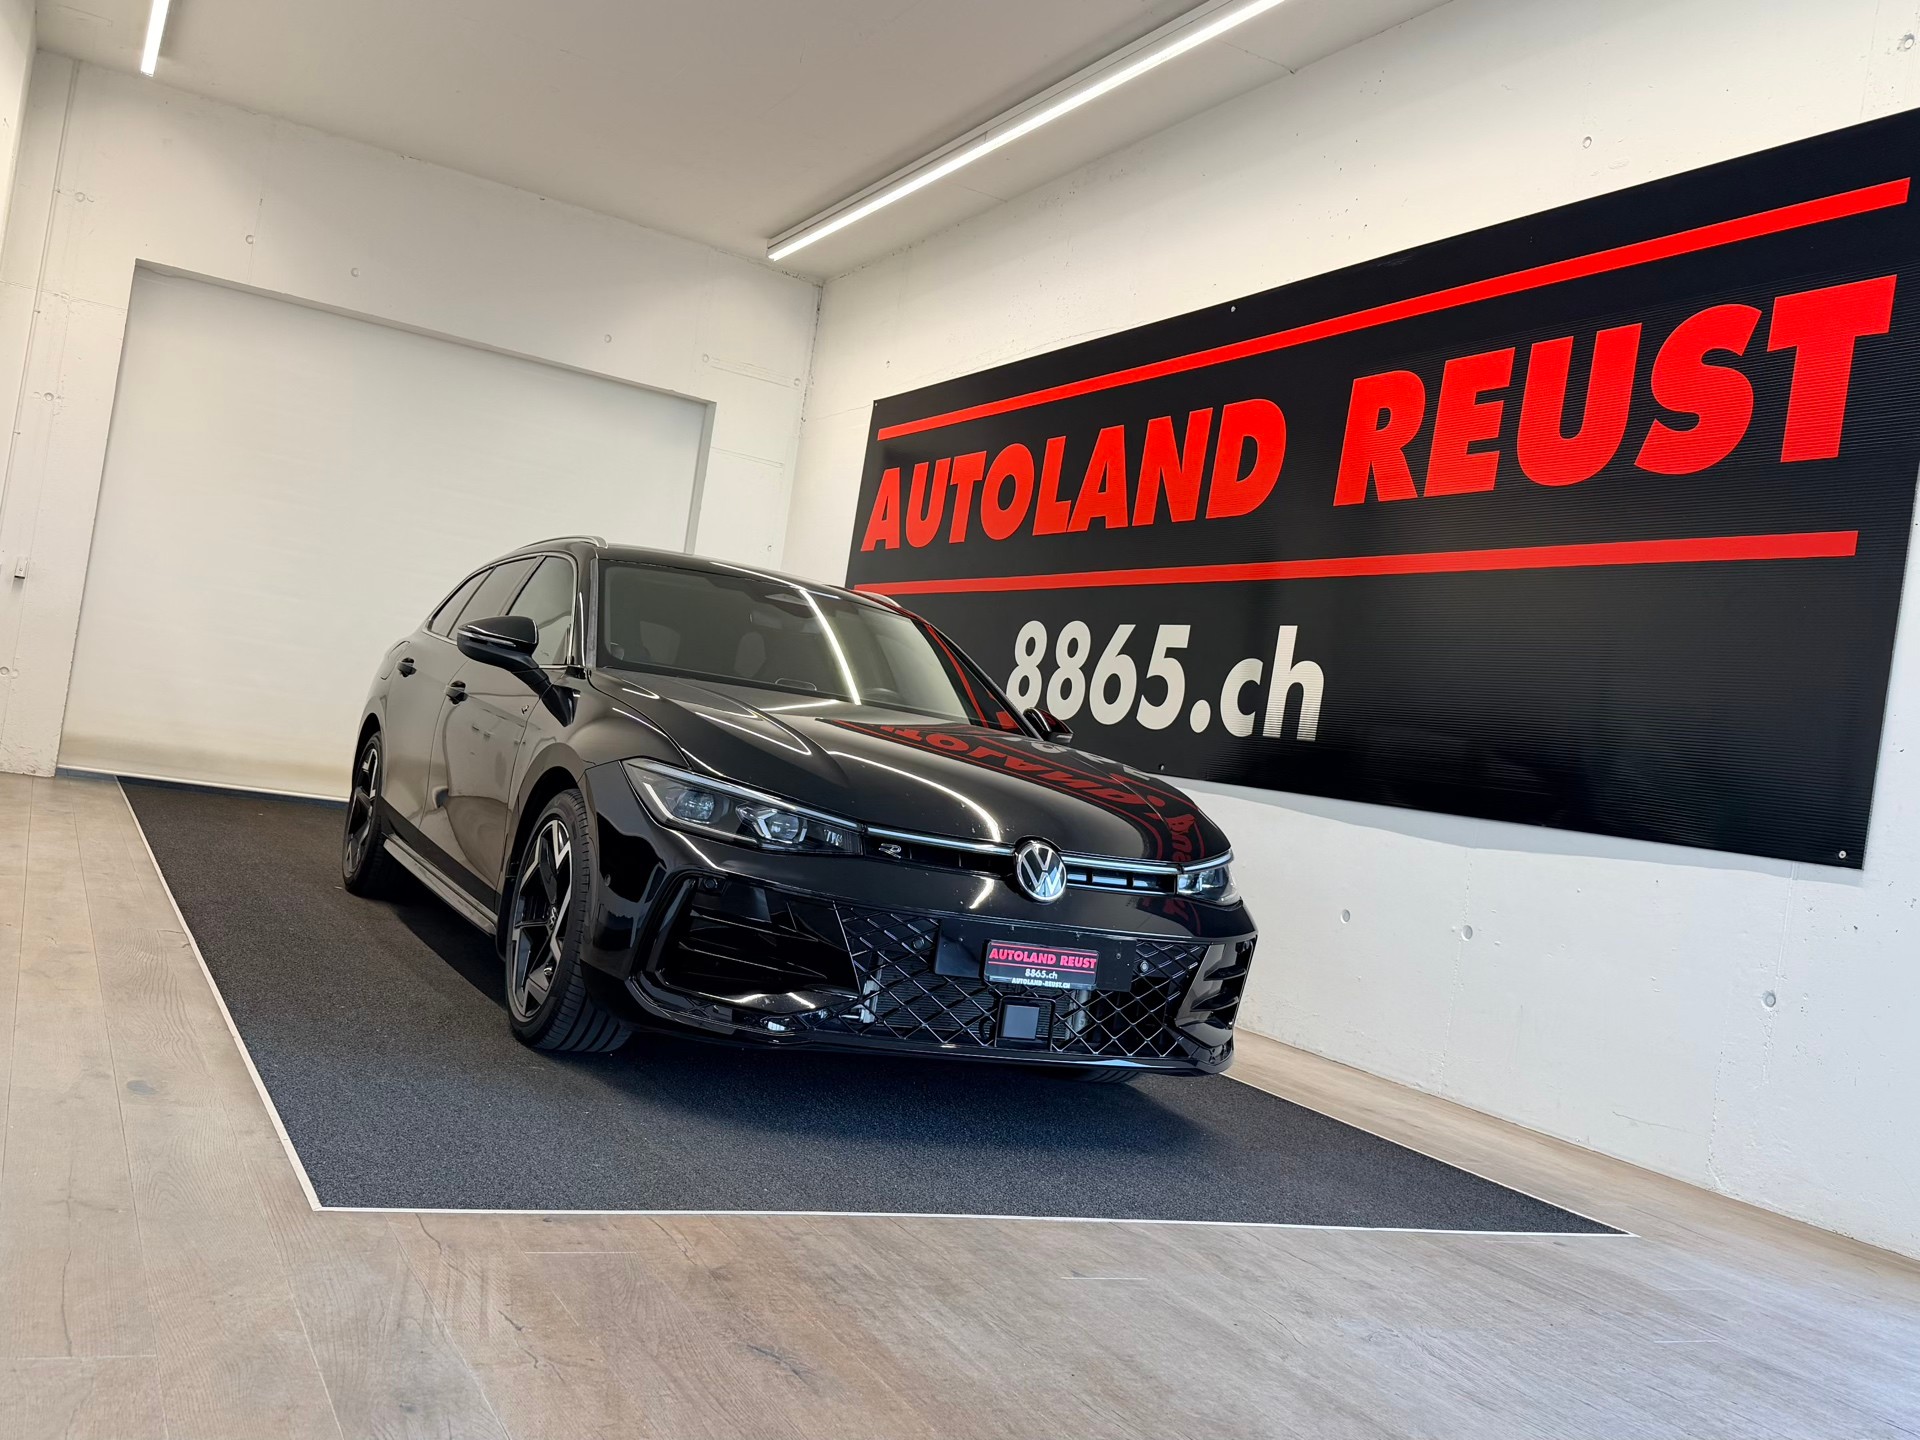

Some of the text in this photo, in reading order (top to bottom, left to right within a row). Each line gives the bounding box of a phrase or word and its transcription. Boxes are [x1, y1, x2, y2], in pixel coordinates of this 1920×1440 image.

[861, 274, 1897, 552] AUTOLAND REUST
[1005, 619, 1325, 742] 8865.ch
[988, 947, 1097, 969] AUTOLAND REUST
[1011, 977, 1071, 989] AUTOLAND-REUST.CH
[1024, 968, 1058, 980] 8865.ch
